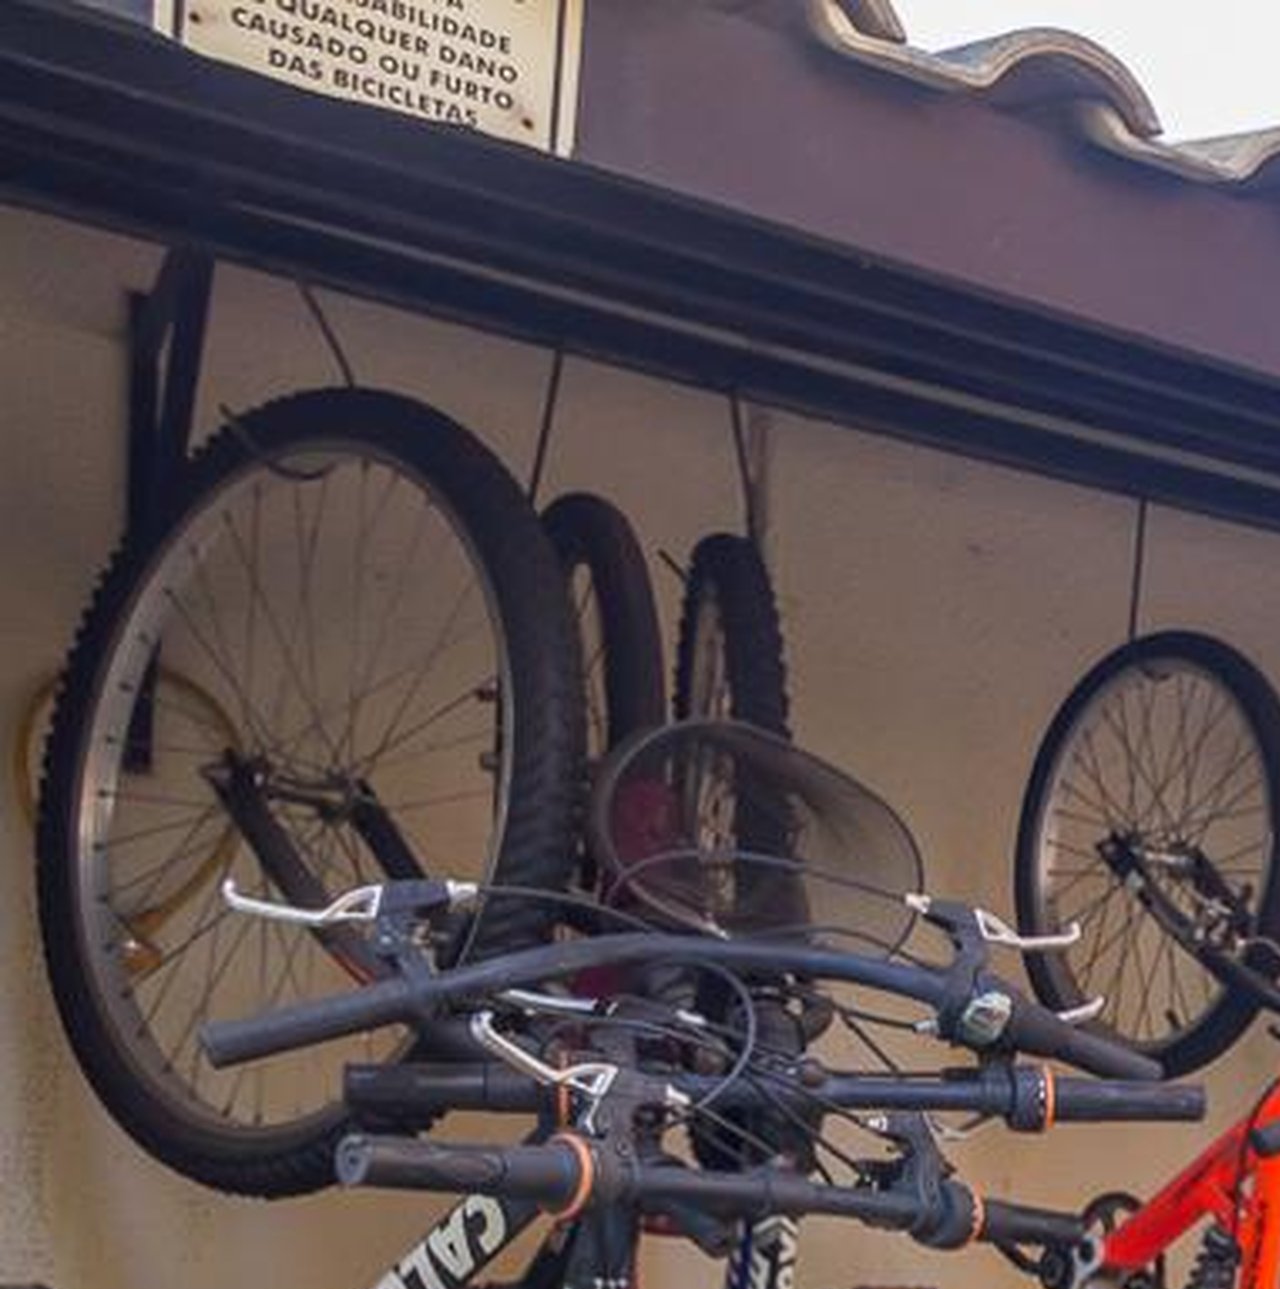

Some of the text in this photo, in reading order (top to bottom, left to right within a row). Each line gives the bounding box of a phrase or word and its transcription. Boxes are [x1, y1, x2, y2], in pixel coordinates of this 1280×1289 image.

[231, 7, 514, 110] CAUSADO OU FURTO
[275, 0, 518, 84] QUALQUER DANO
[269, 50, 478, 126] DAS BICICLETAS
